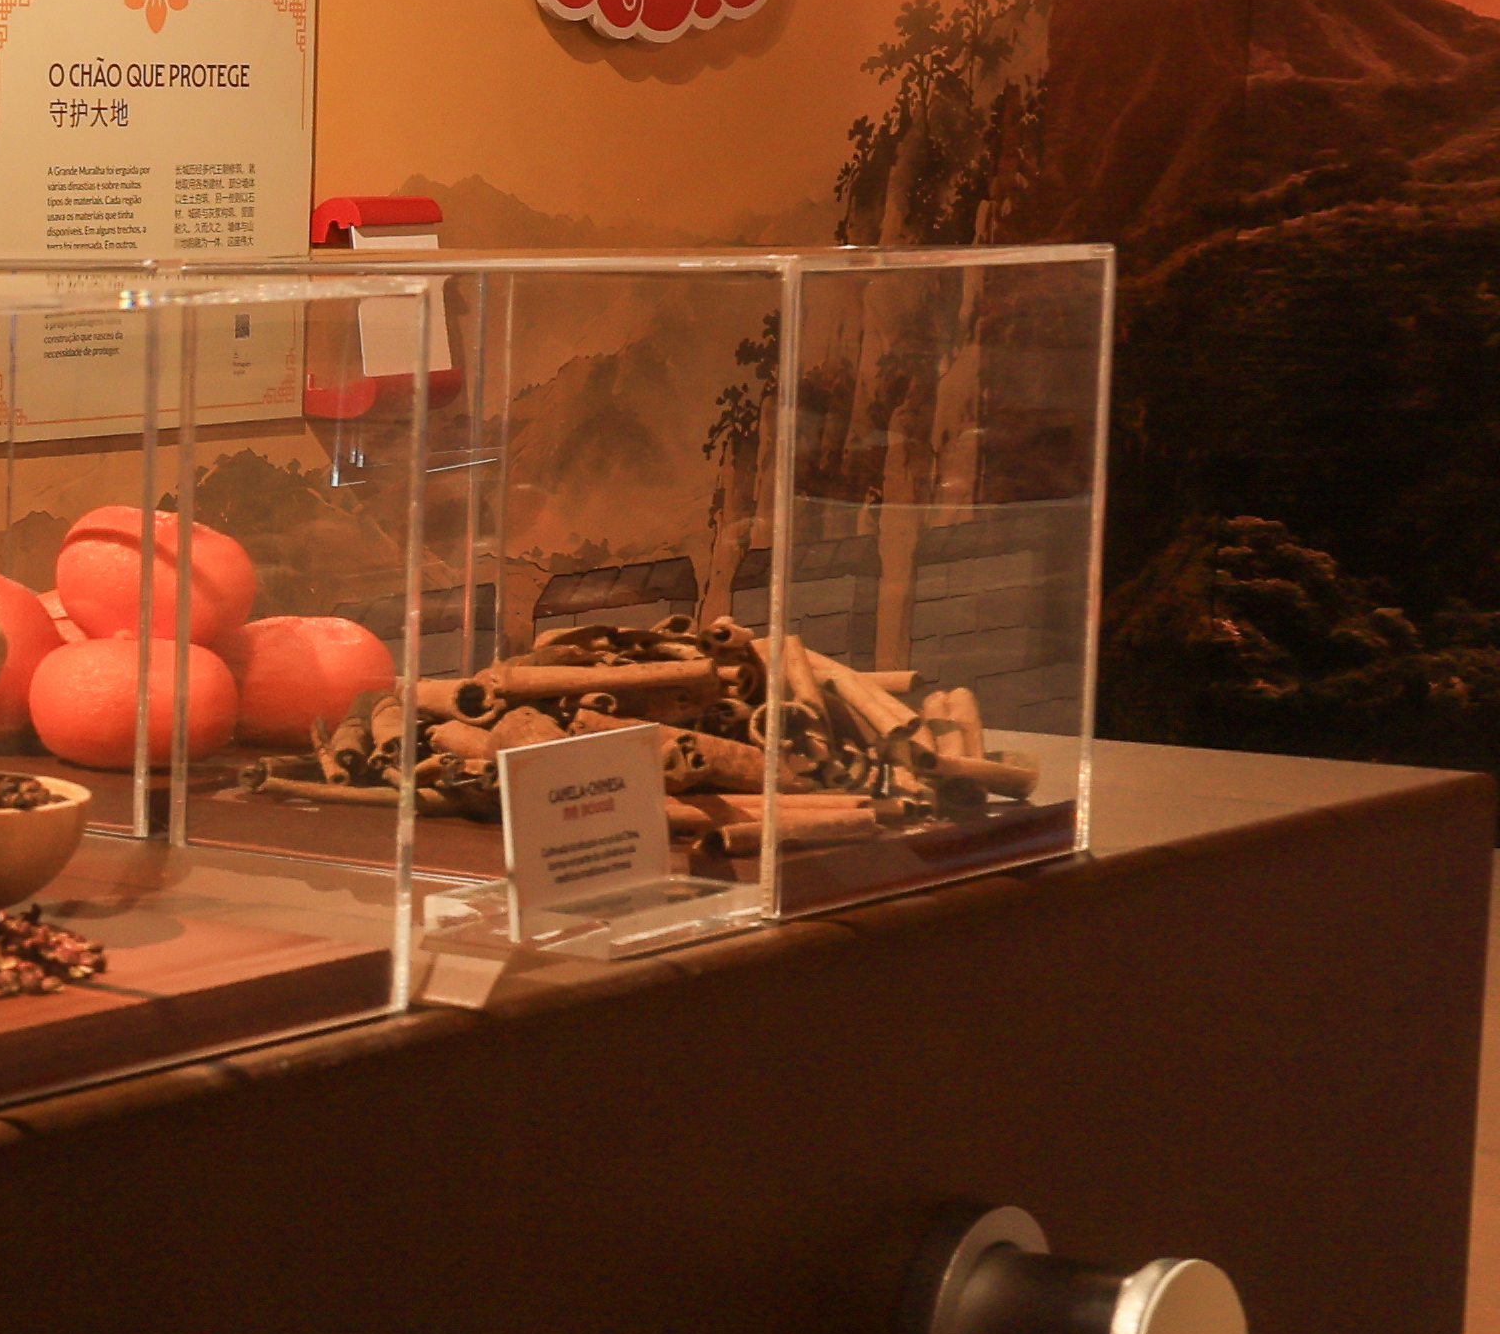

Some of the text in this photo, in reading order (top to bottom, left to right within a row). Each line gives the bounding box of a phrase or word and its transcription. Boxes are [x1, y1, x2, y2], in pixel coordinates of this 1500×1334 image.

[49, 57, 250, 87] O CHÃO QUE PROTEGE
[49, 98, 129, 128] 守护大地
